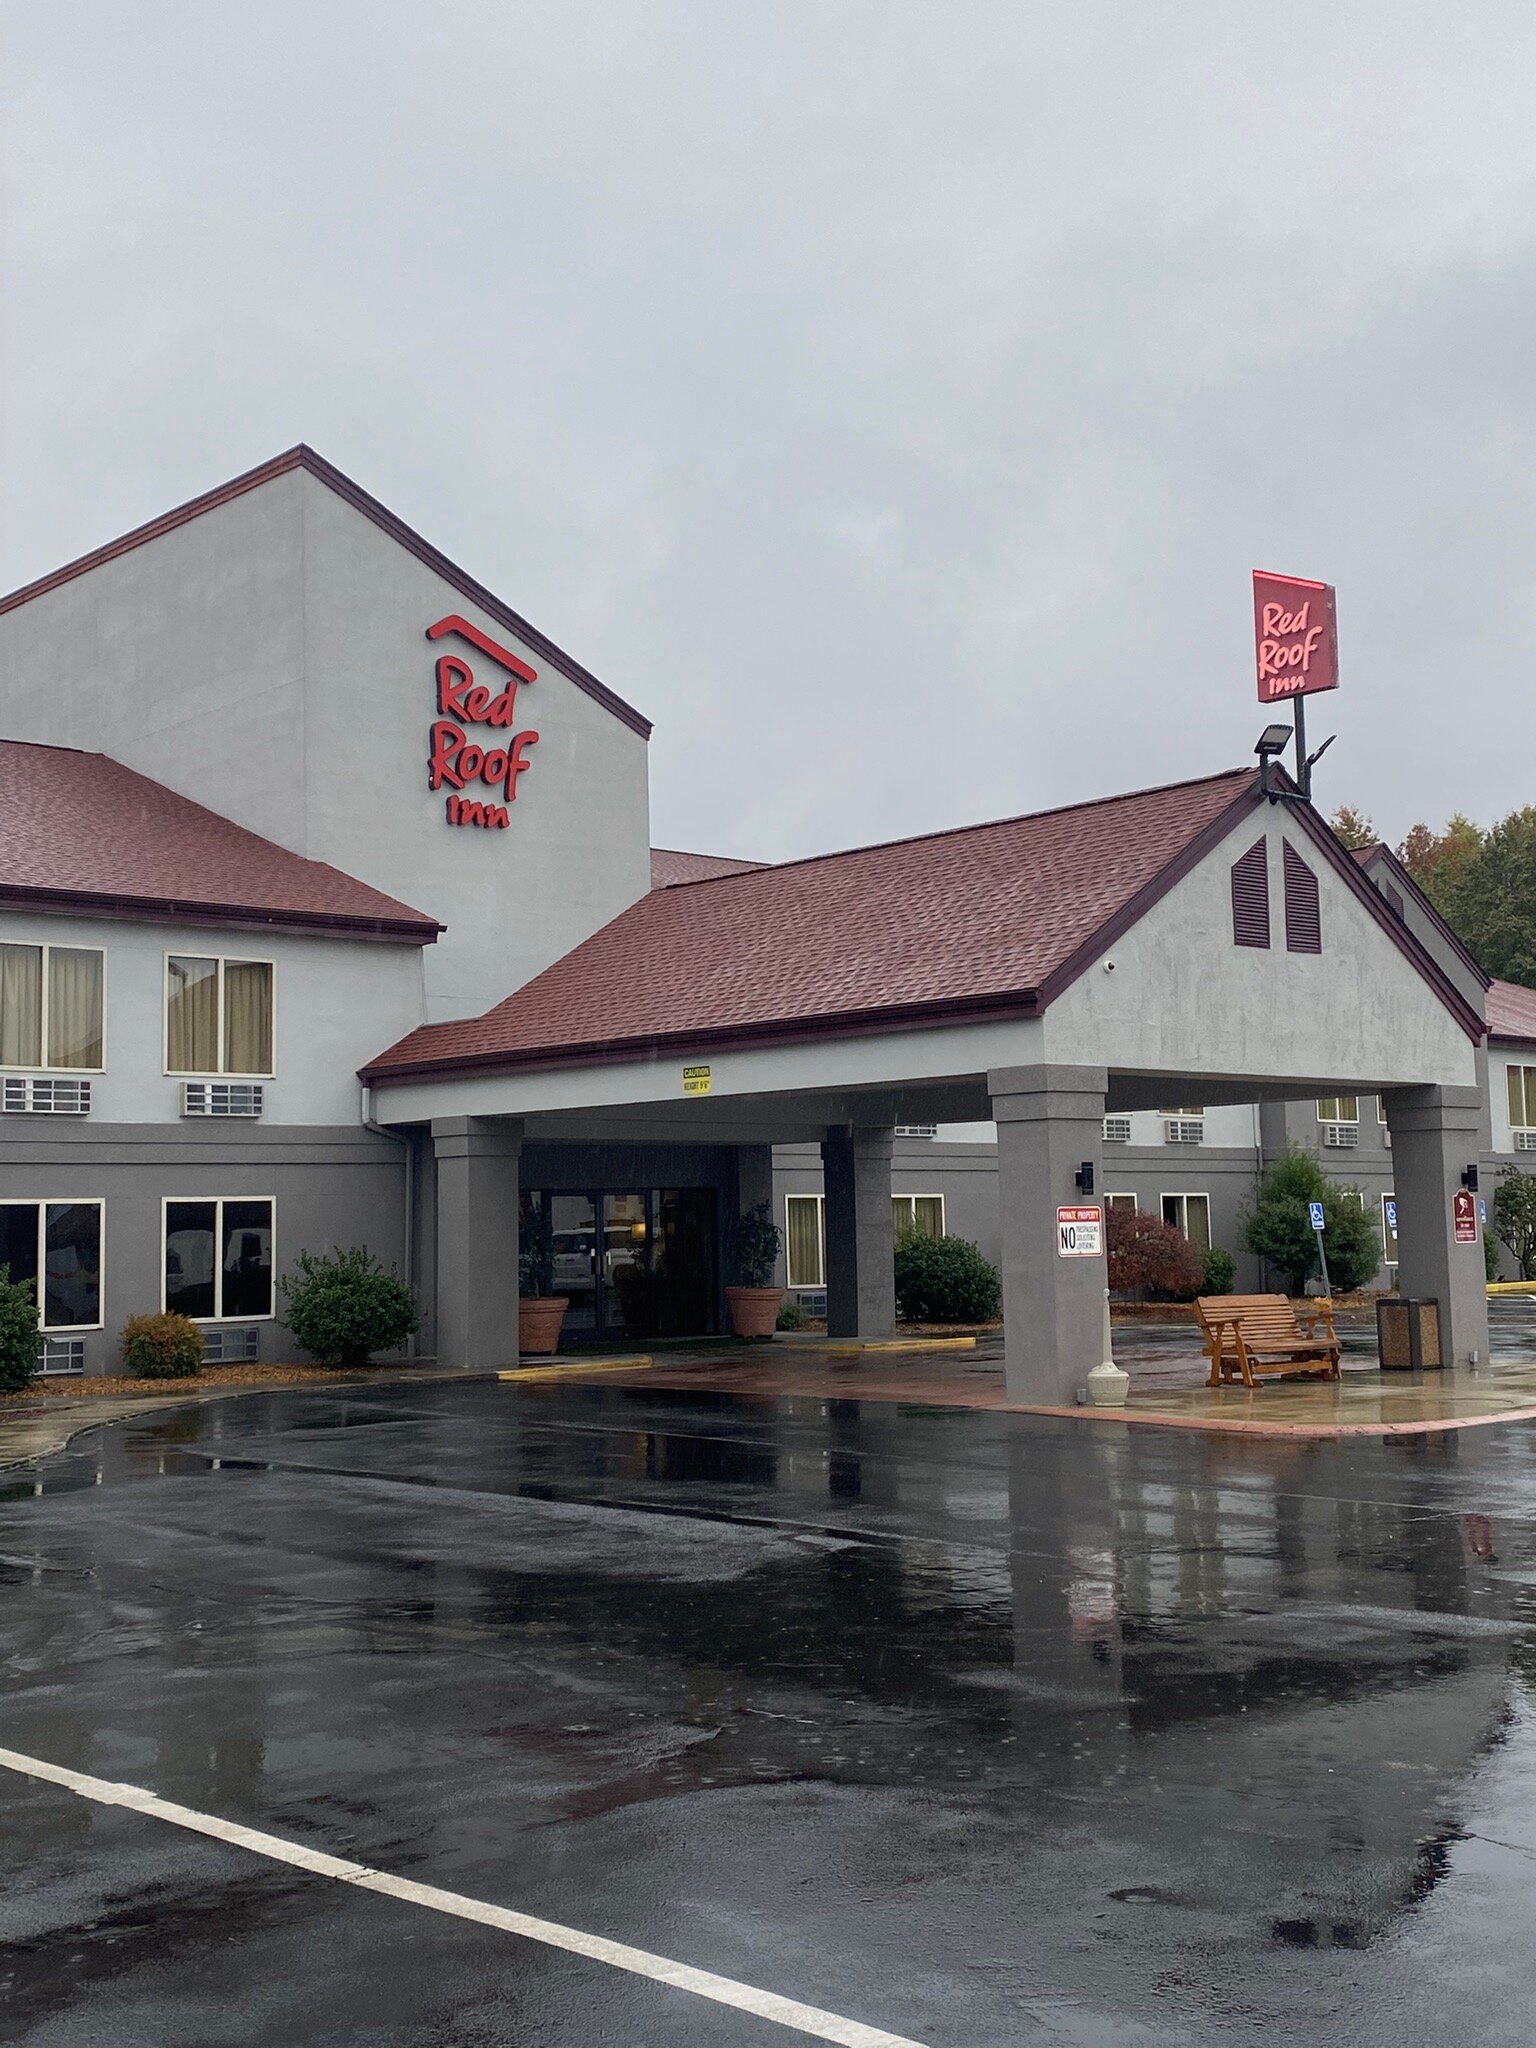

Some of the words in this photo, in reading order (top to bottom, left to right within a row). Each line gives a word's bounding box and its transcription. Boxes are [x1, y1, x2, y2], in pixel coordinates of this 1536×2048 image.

[1263, 601, 1310, 637] Red
[1259, 625, 1323, 680] Roof
[435, 655, 518, 728] Red
[428, 720, 540, 802] Roof
[684, 1068, 709, 1078] CAUTION
[1060, 1211, 1077, 1220] PRIVATE
[1077, 1210, 1099, 1220] PROPERTY
[1061, 1226, 1076, 1249] NO
